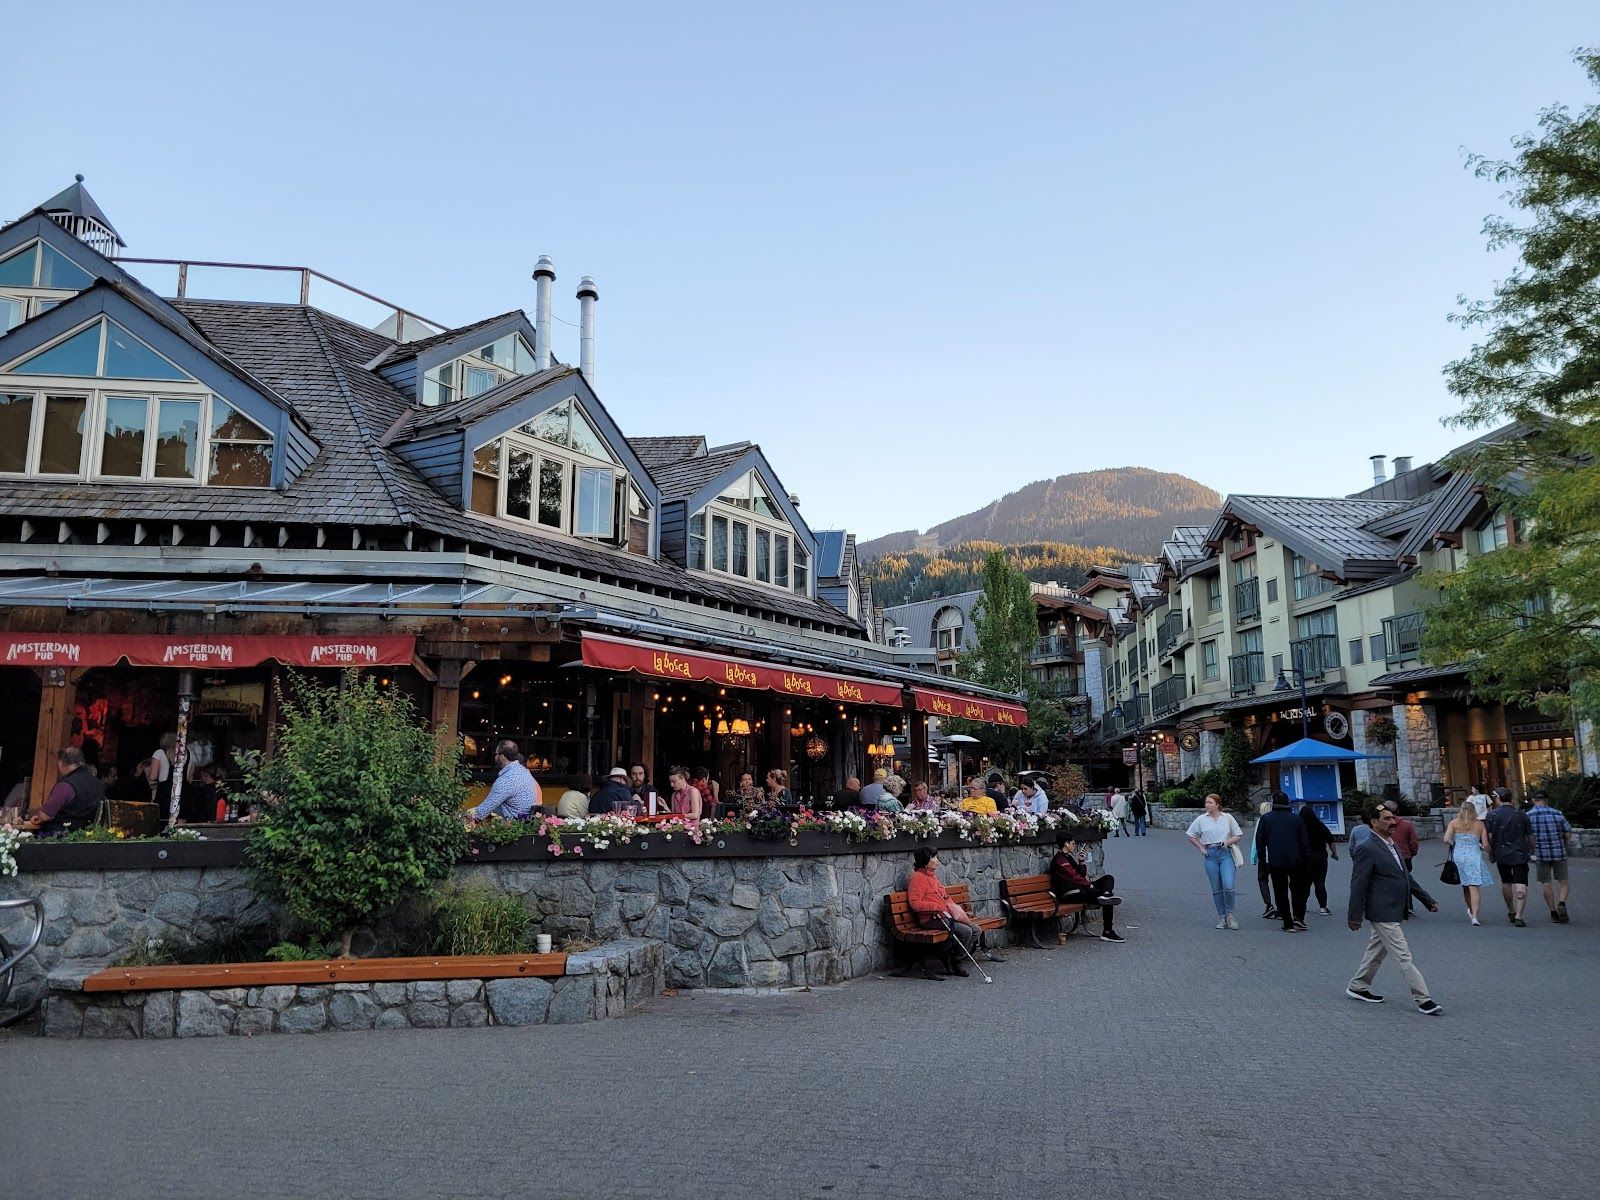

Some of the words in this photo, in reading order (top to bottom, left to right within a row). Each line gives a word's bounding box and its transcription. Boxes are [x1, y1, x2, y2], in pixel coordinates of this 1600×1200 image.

[6, 642, 80, 661] AMSTERDAM
[35, 652, 54, 660] PUB
[163, 644, 233, 662] AMSTERDAM
[189, 653, 208, 661] PUB
[311, 645, 377, 662] AMSTERDAM
[336, 653, 353, 661] PUB
[1286, 707, 1316, 719] CRYSAL
